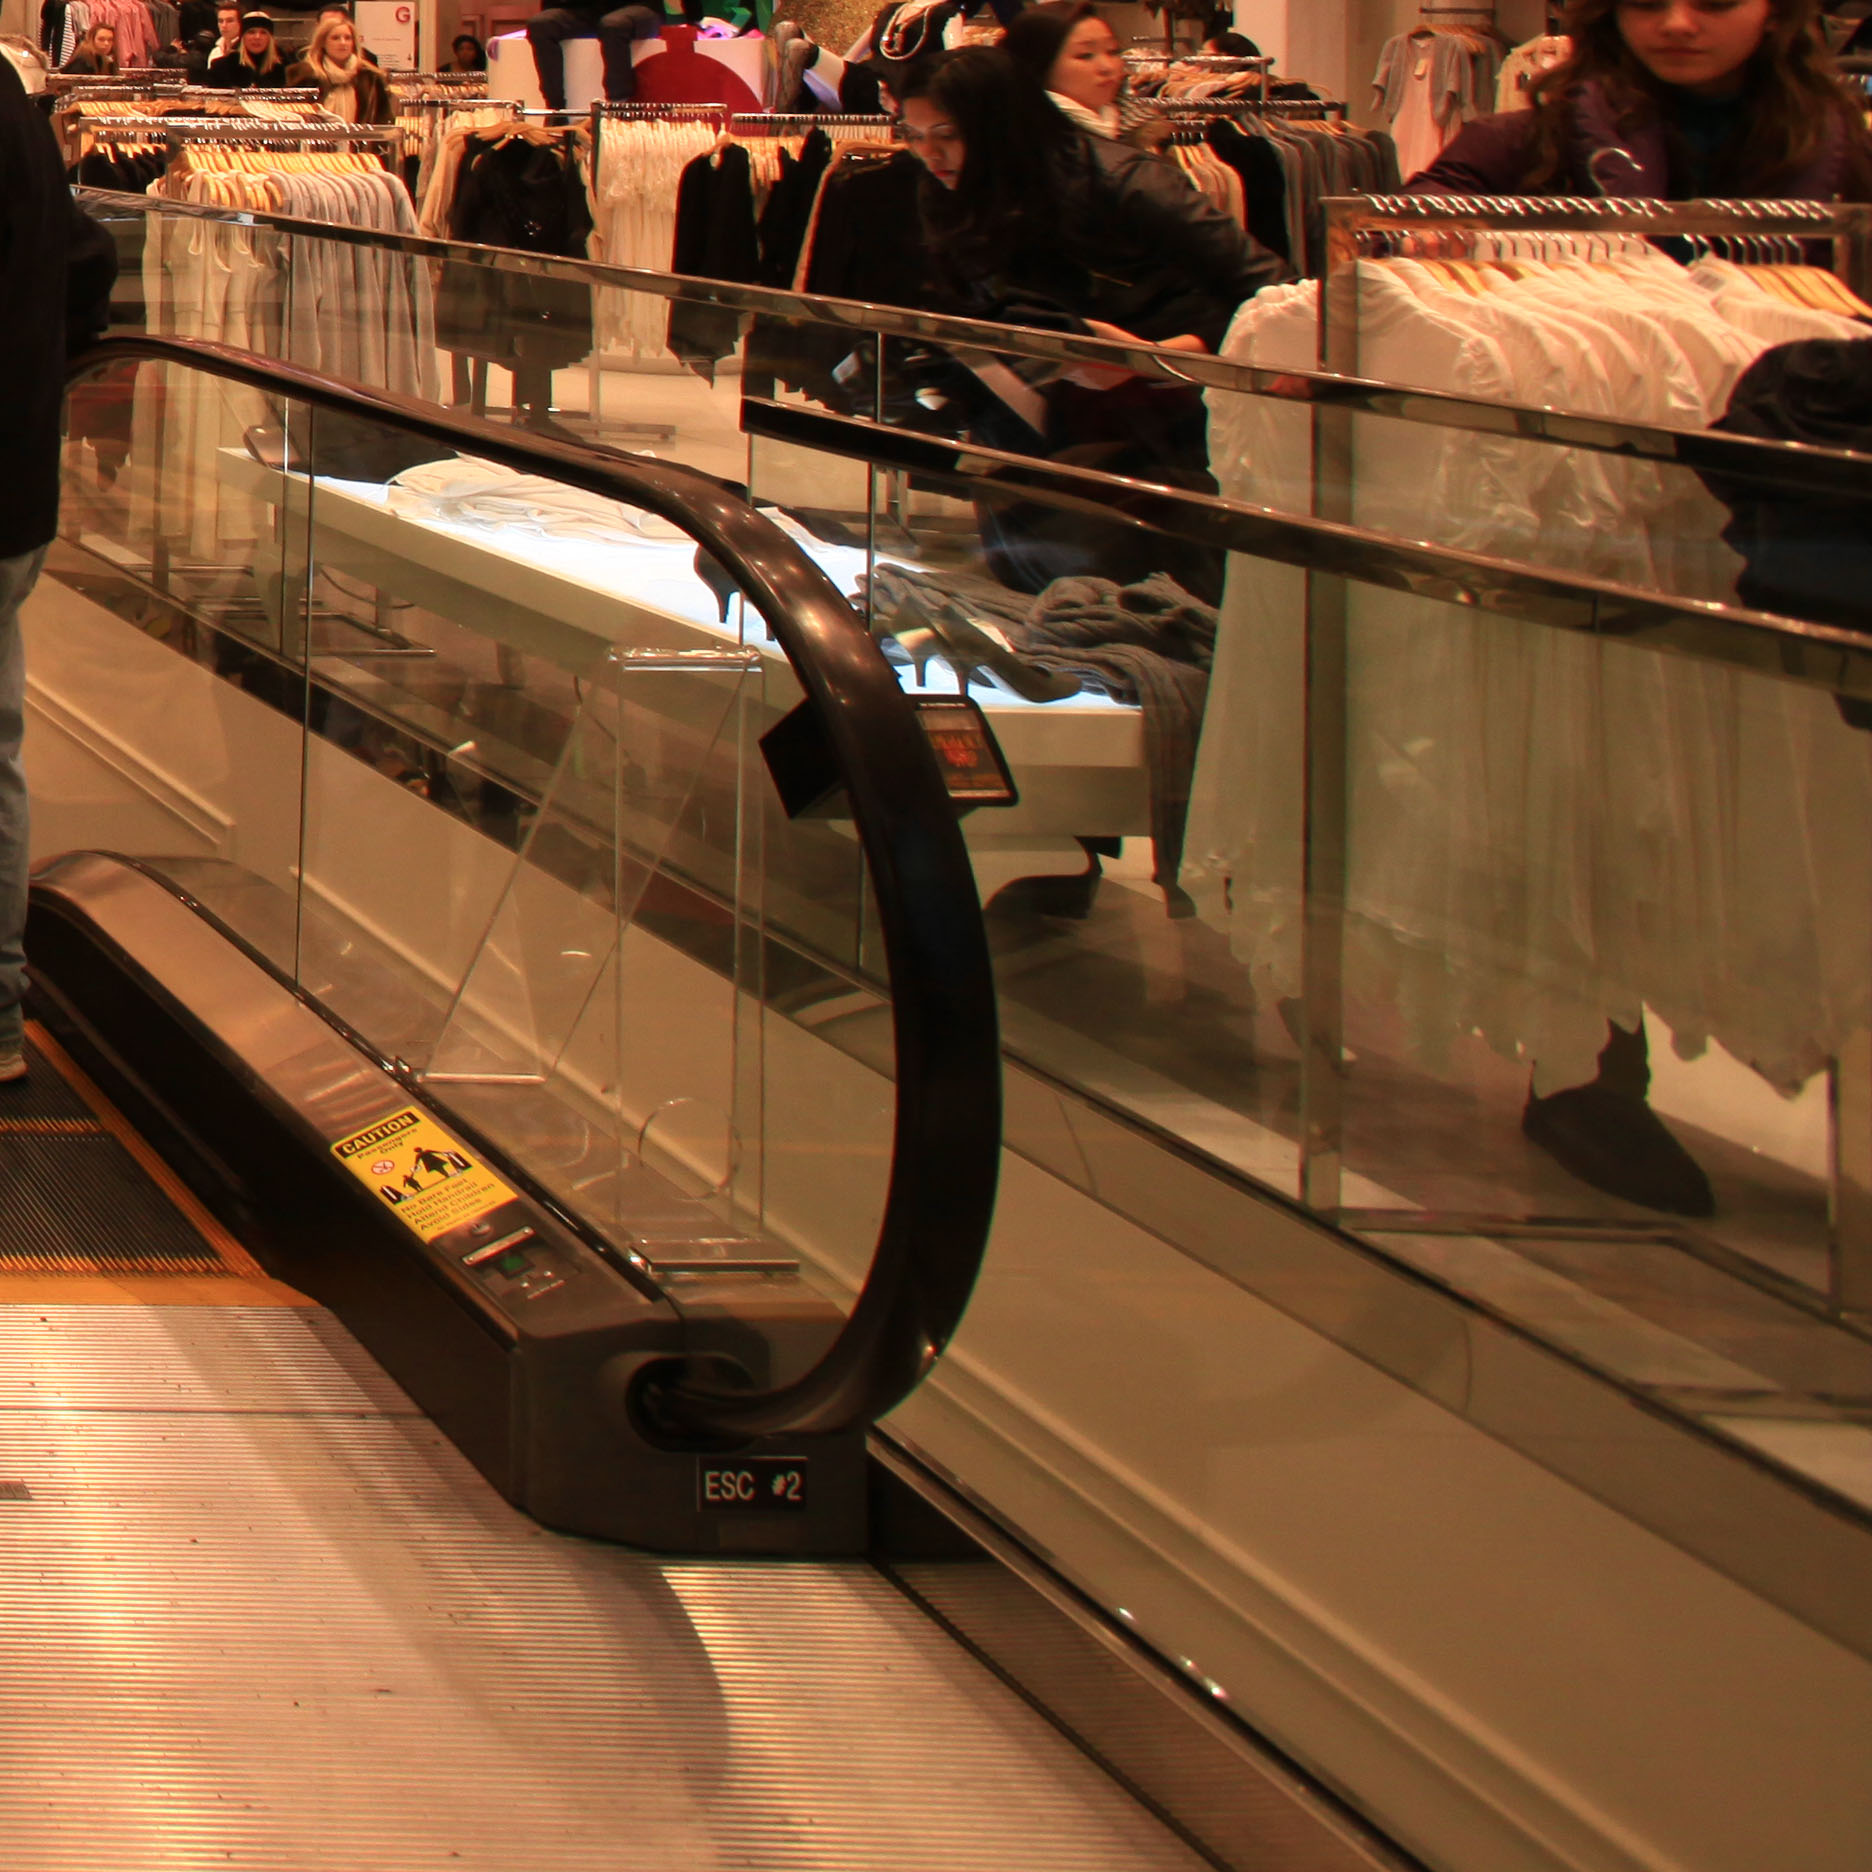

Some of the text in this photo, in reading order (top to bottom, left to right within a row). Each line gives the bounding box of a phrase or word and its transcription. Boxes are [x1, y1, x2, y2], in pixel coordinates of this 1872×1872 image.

[341, 1114, 415, 1155] CAUTION
[703, 1470, 804, 1502] ESC #2
